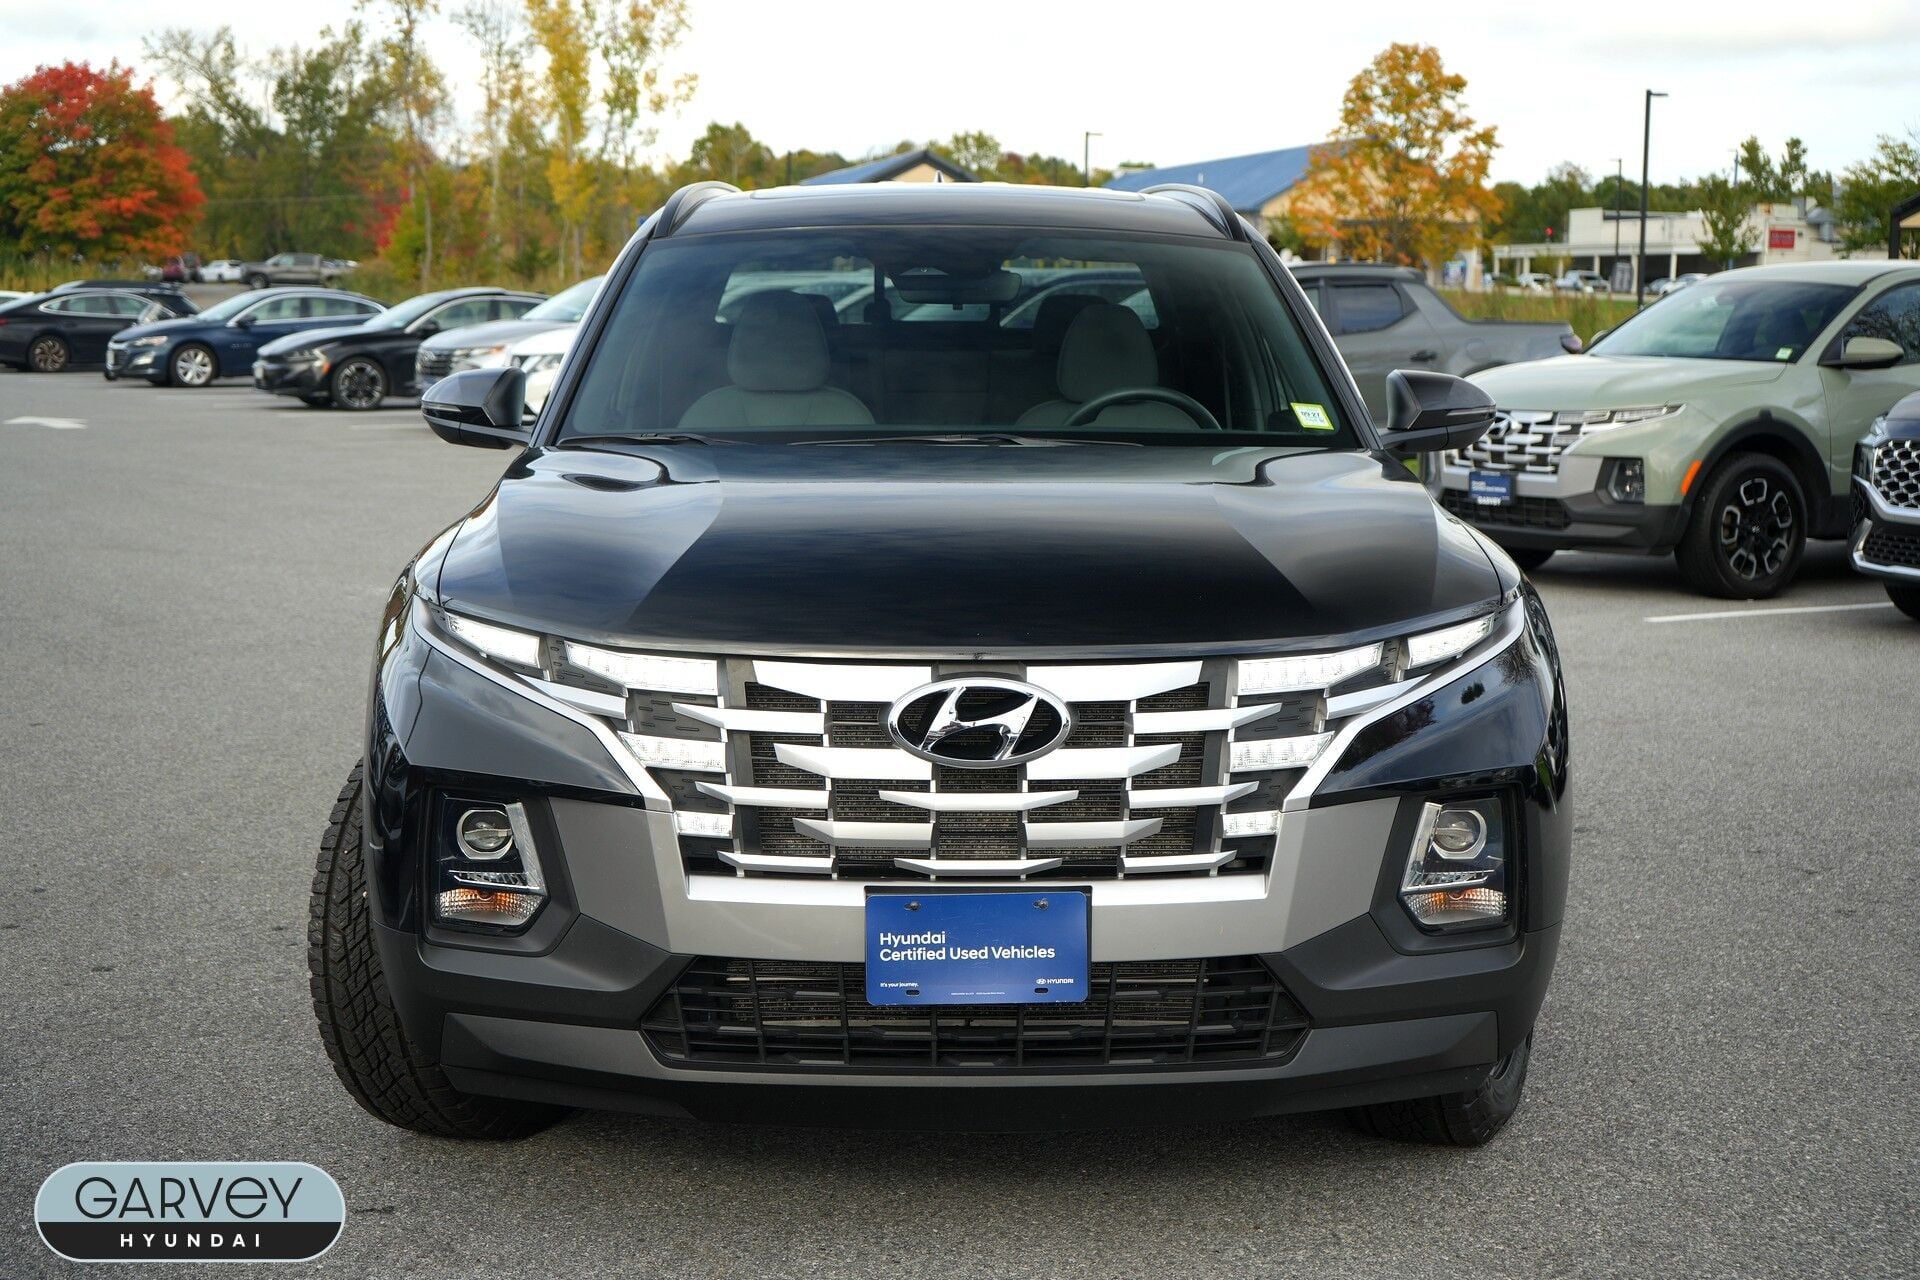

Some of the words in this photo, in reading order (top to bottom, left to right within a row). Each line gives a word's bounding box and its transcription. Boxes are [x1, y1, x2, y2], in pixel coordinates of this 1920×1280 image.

[879, 931, 946, 948] Hyundai
[879, 947, 946, 961] Certified
[949, 946, 988, 960] Used
[991, 944, 1056, 959] Vehicles
